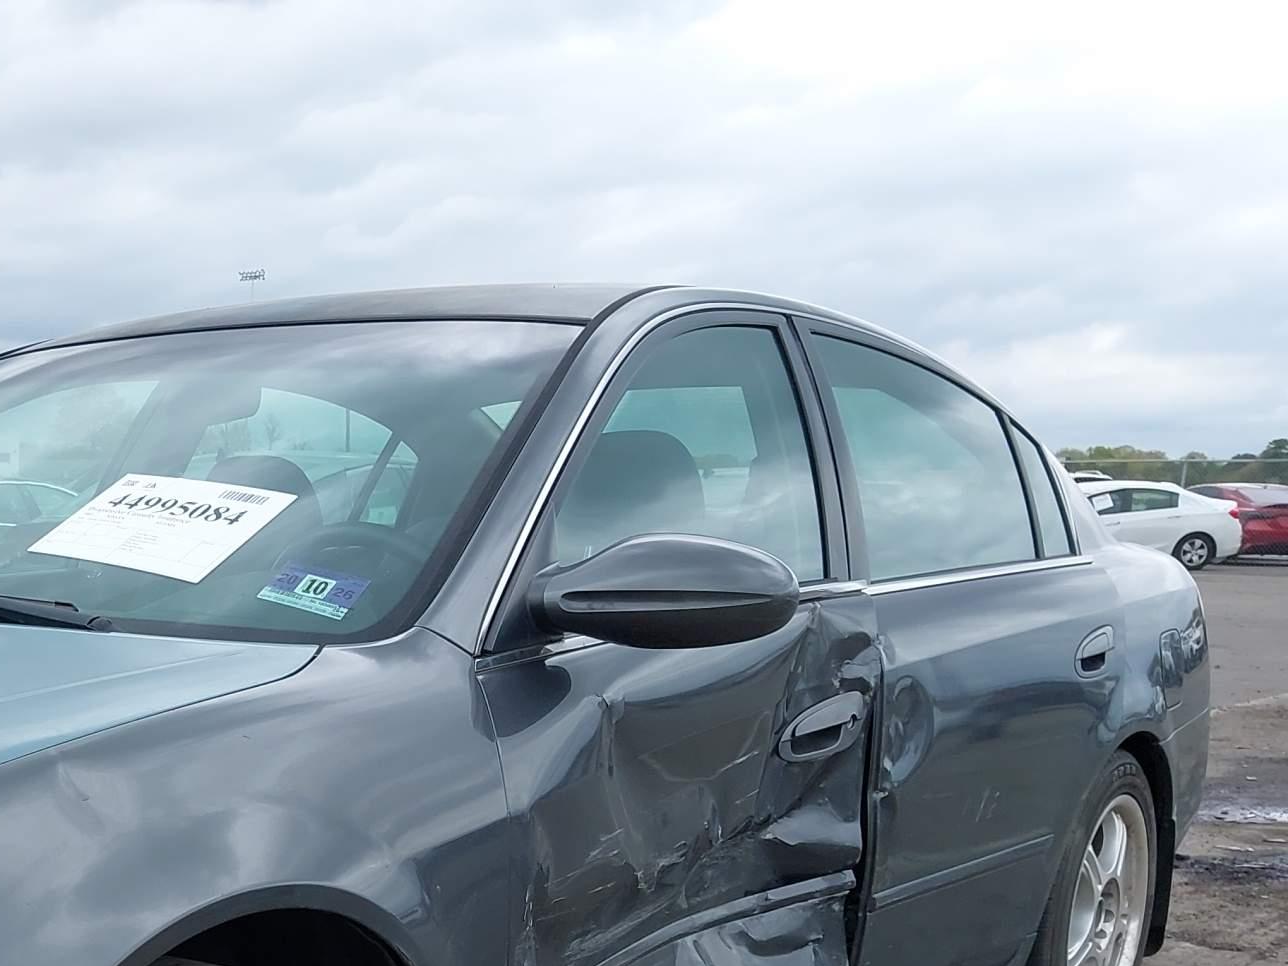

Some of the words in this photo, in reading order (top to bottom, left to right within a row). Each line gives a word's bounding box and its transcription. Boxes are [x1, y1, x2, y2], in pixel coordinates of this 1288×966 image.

[108, 493, 249, 526] 44995084
[277, 573, 298, 585] 20
[301, 578, 329, 596] 10
[332, 587, 355, 600] 26
